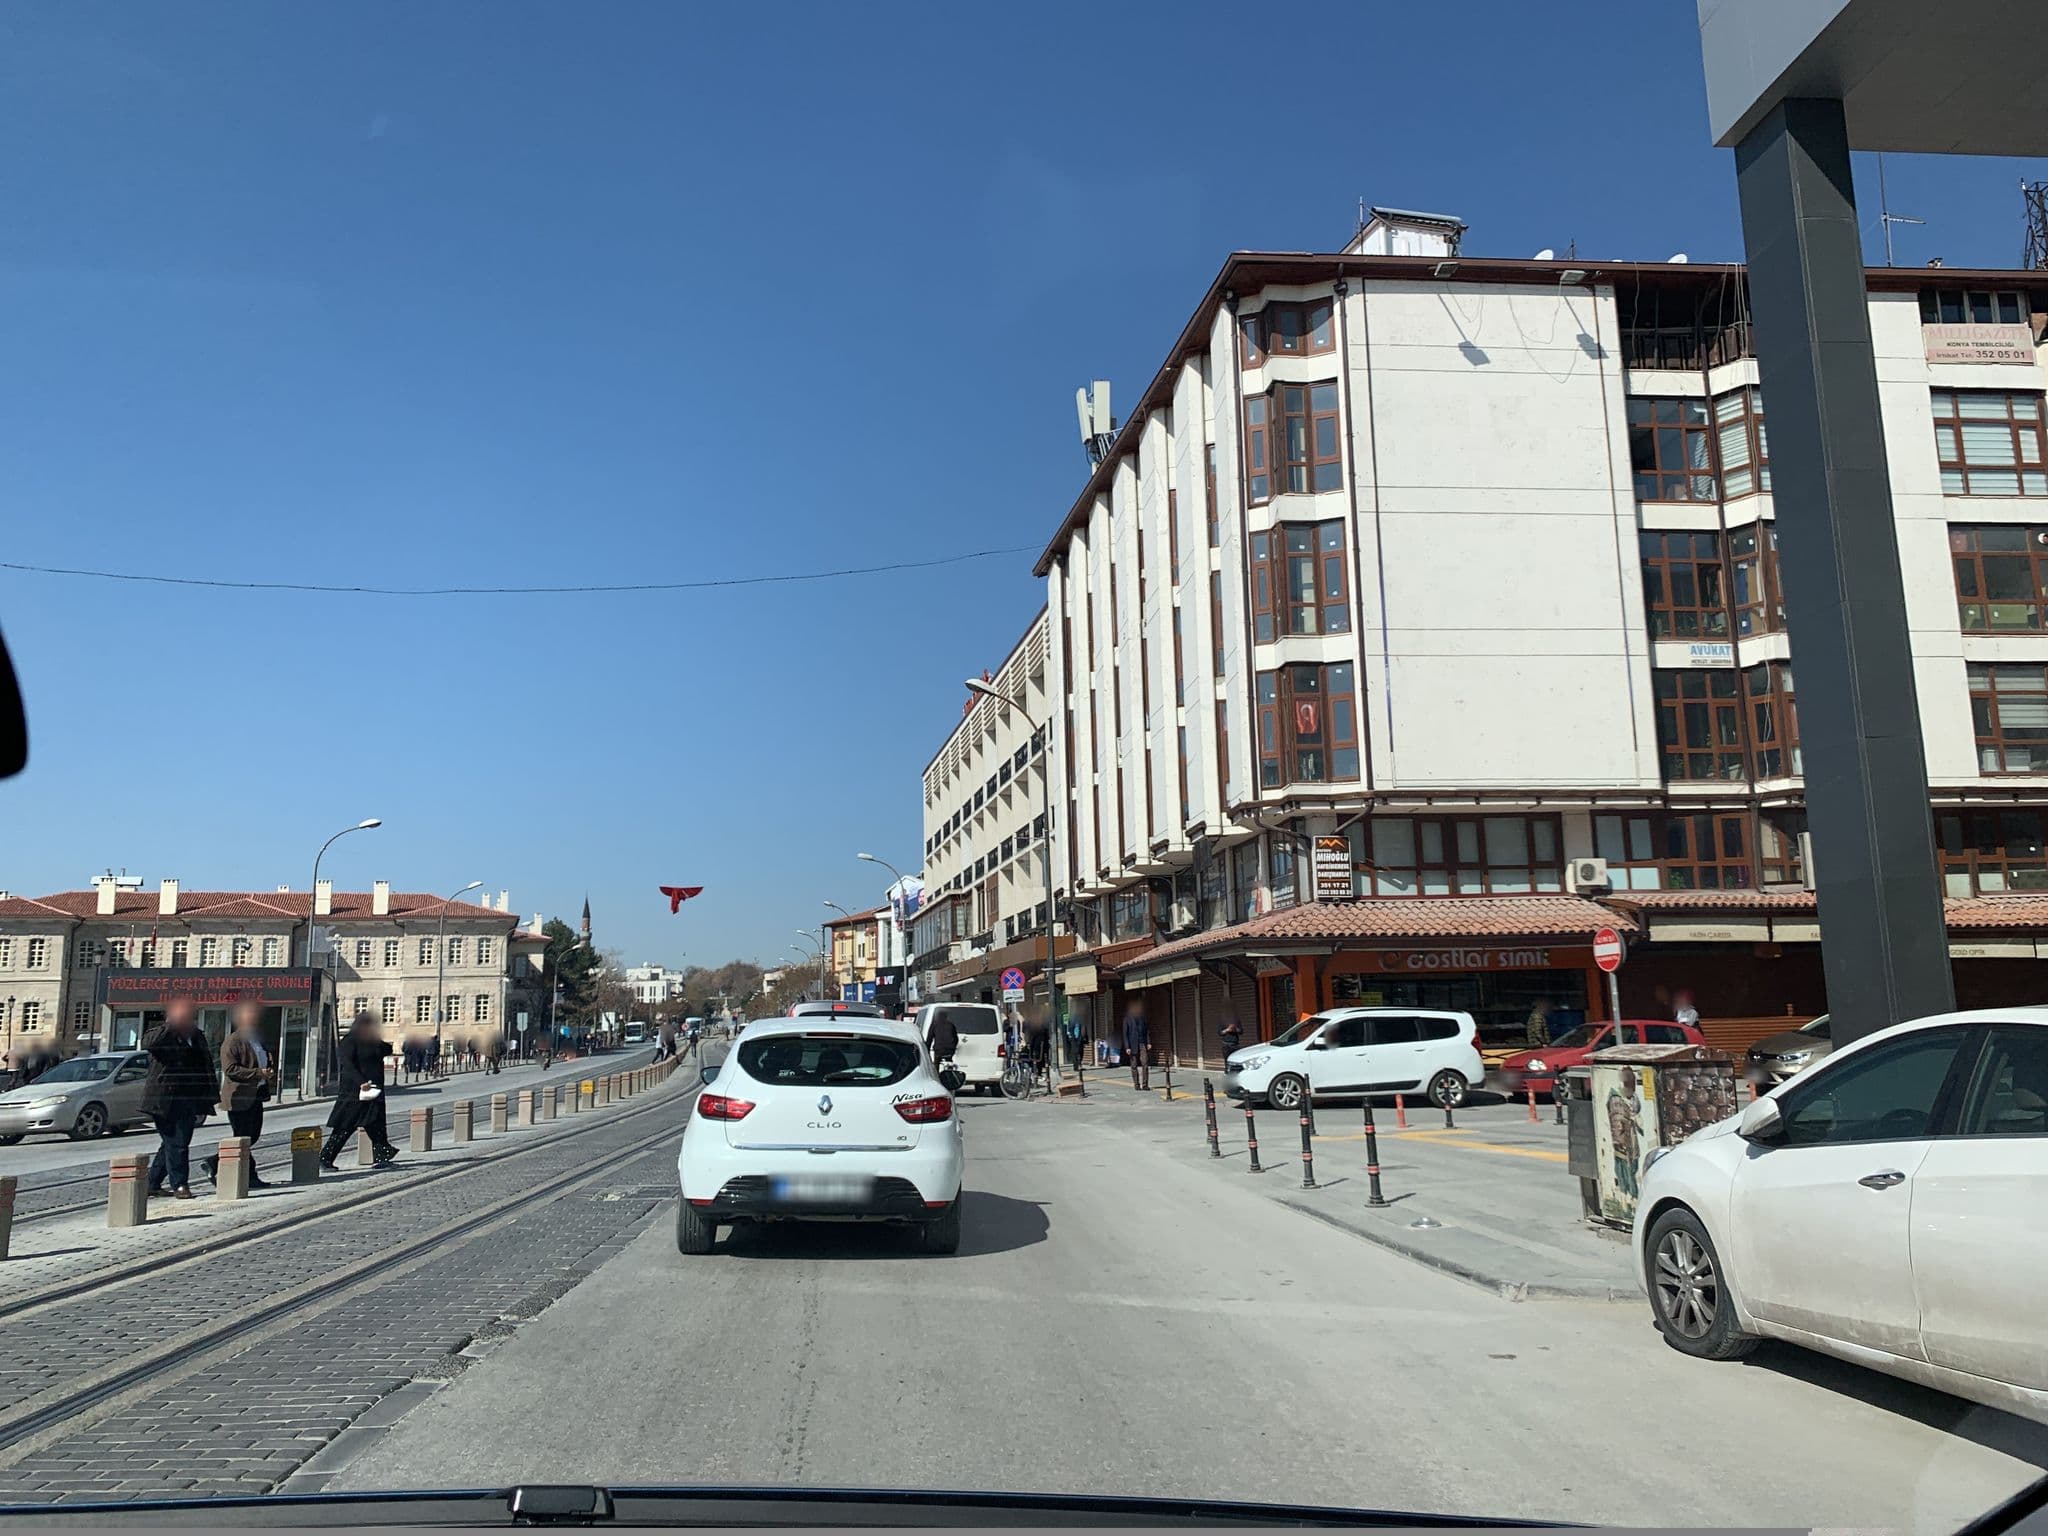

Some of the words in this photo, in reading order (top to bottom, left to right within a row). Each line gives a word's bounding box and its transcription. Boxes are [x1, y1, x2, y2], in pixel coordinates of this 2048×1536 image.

[1976, 350, 1995, 359] 352
[1997, 351, 2011, 360] 05
[2013, 351, 2026, 360] 01
[1690, 645, 1731, 656] AVUKAT
[111, 976, 169, 990] YÜZLERCE
[889, 1093, 924, 1105] Nisa
[806, 1121, 842, 1129] CLIO
